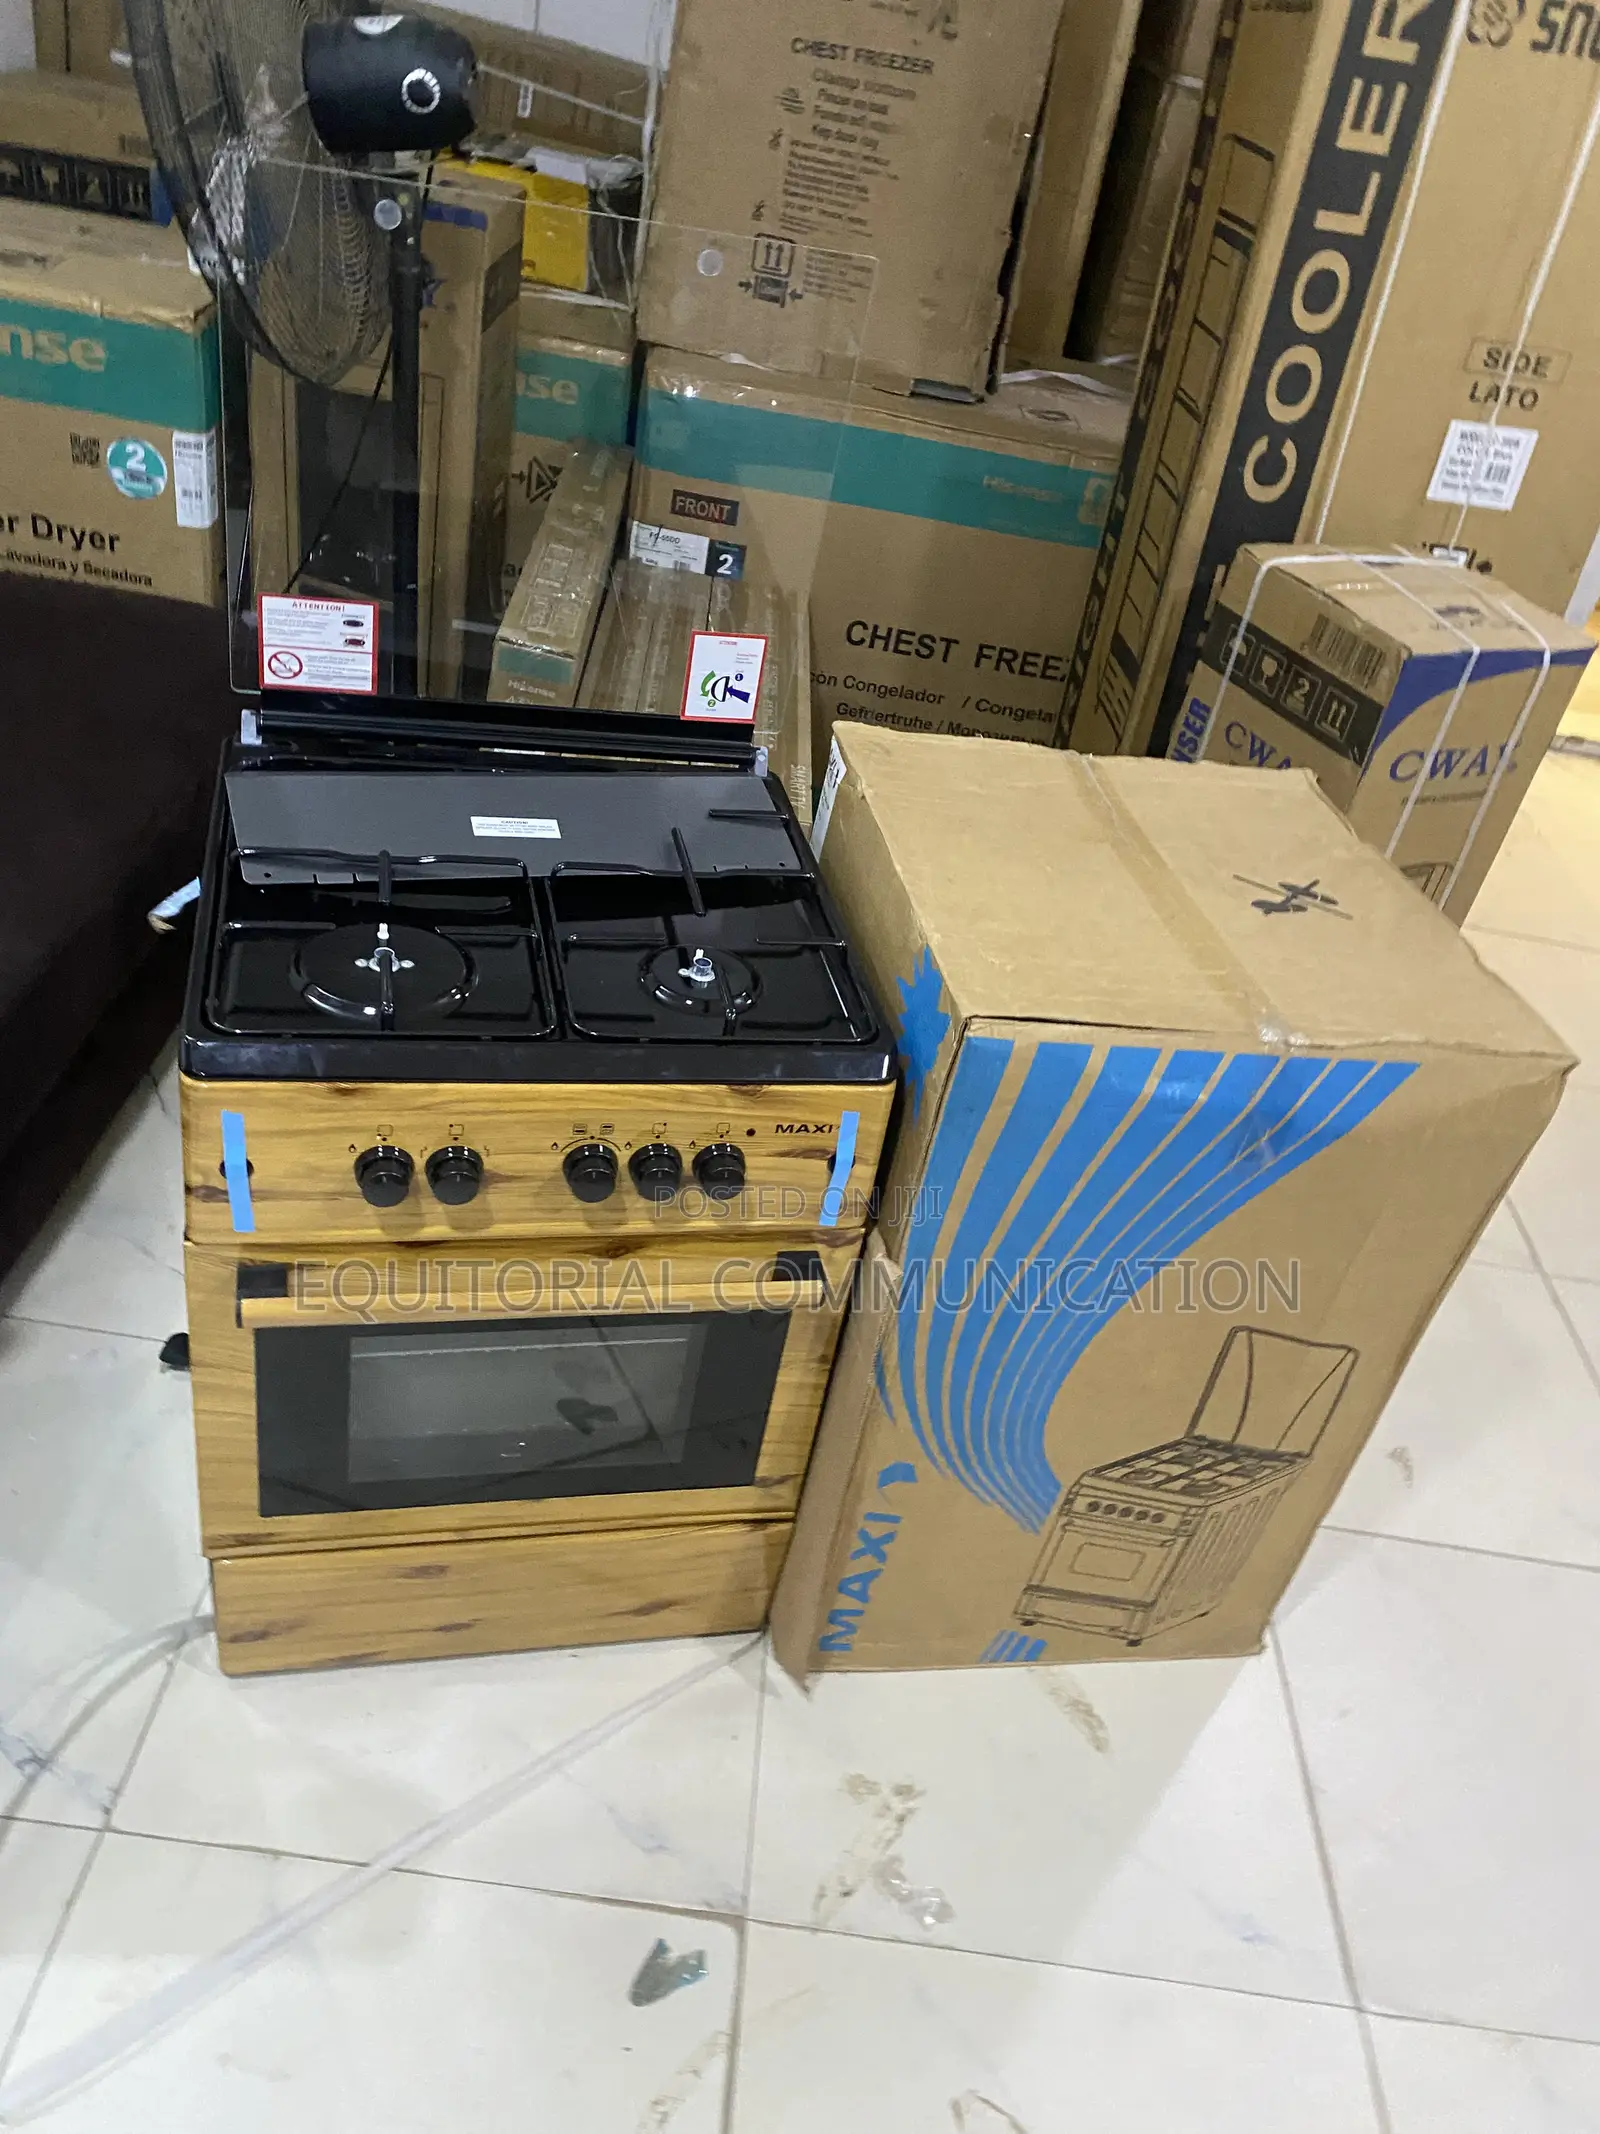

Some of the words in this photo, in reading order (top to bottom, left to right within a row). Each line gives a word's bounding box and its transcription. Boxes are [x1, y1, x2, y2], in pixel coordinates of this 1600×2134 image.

[791, 36, 849, 62] CHEST
[853, 47, 935, 75] FREEZER
[1241, 0, 1434, 503] COOLER
[1483, 346, 1553, 379] SIDE
[1469, 381, 1539, 411] LATO
[125, 443, 147, 470] 2
[675, 496, 732, 521] FRONT
[31, 512, 121, 553] Dryer
[717, 554, 734, 575] 2
[845, 619, 959, 664] CHEST
[974, 643, 1070, 684] FREE
[843, 674, 945, 707] Congelador
[836, 702, 933, 731] Gefriertruhe
[775, 1124, 833, 1134] MAXI
[818, 1511, 903, 1652] MAXI
